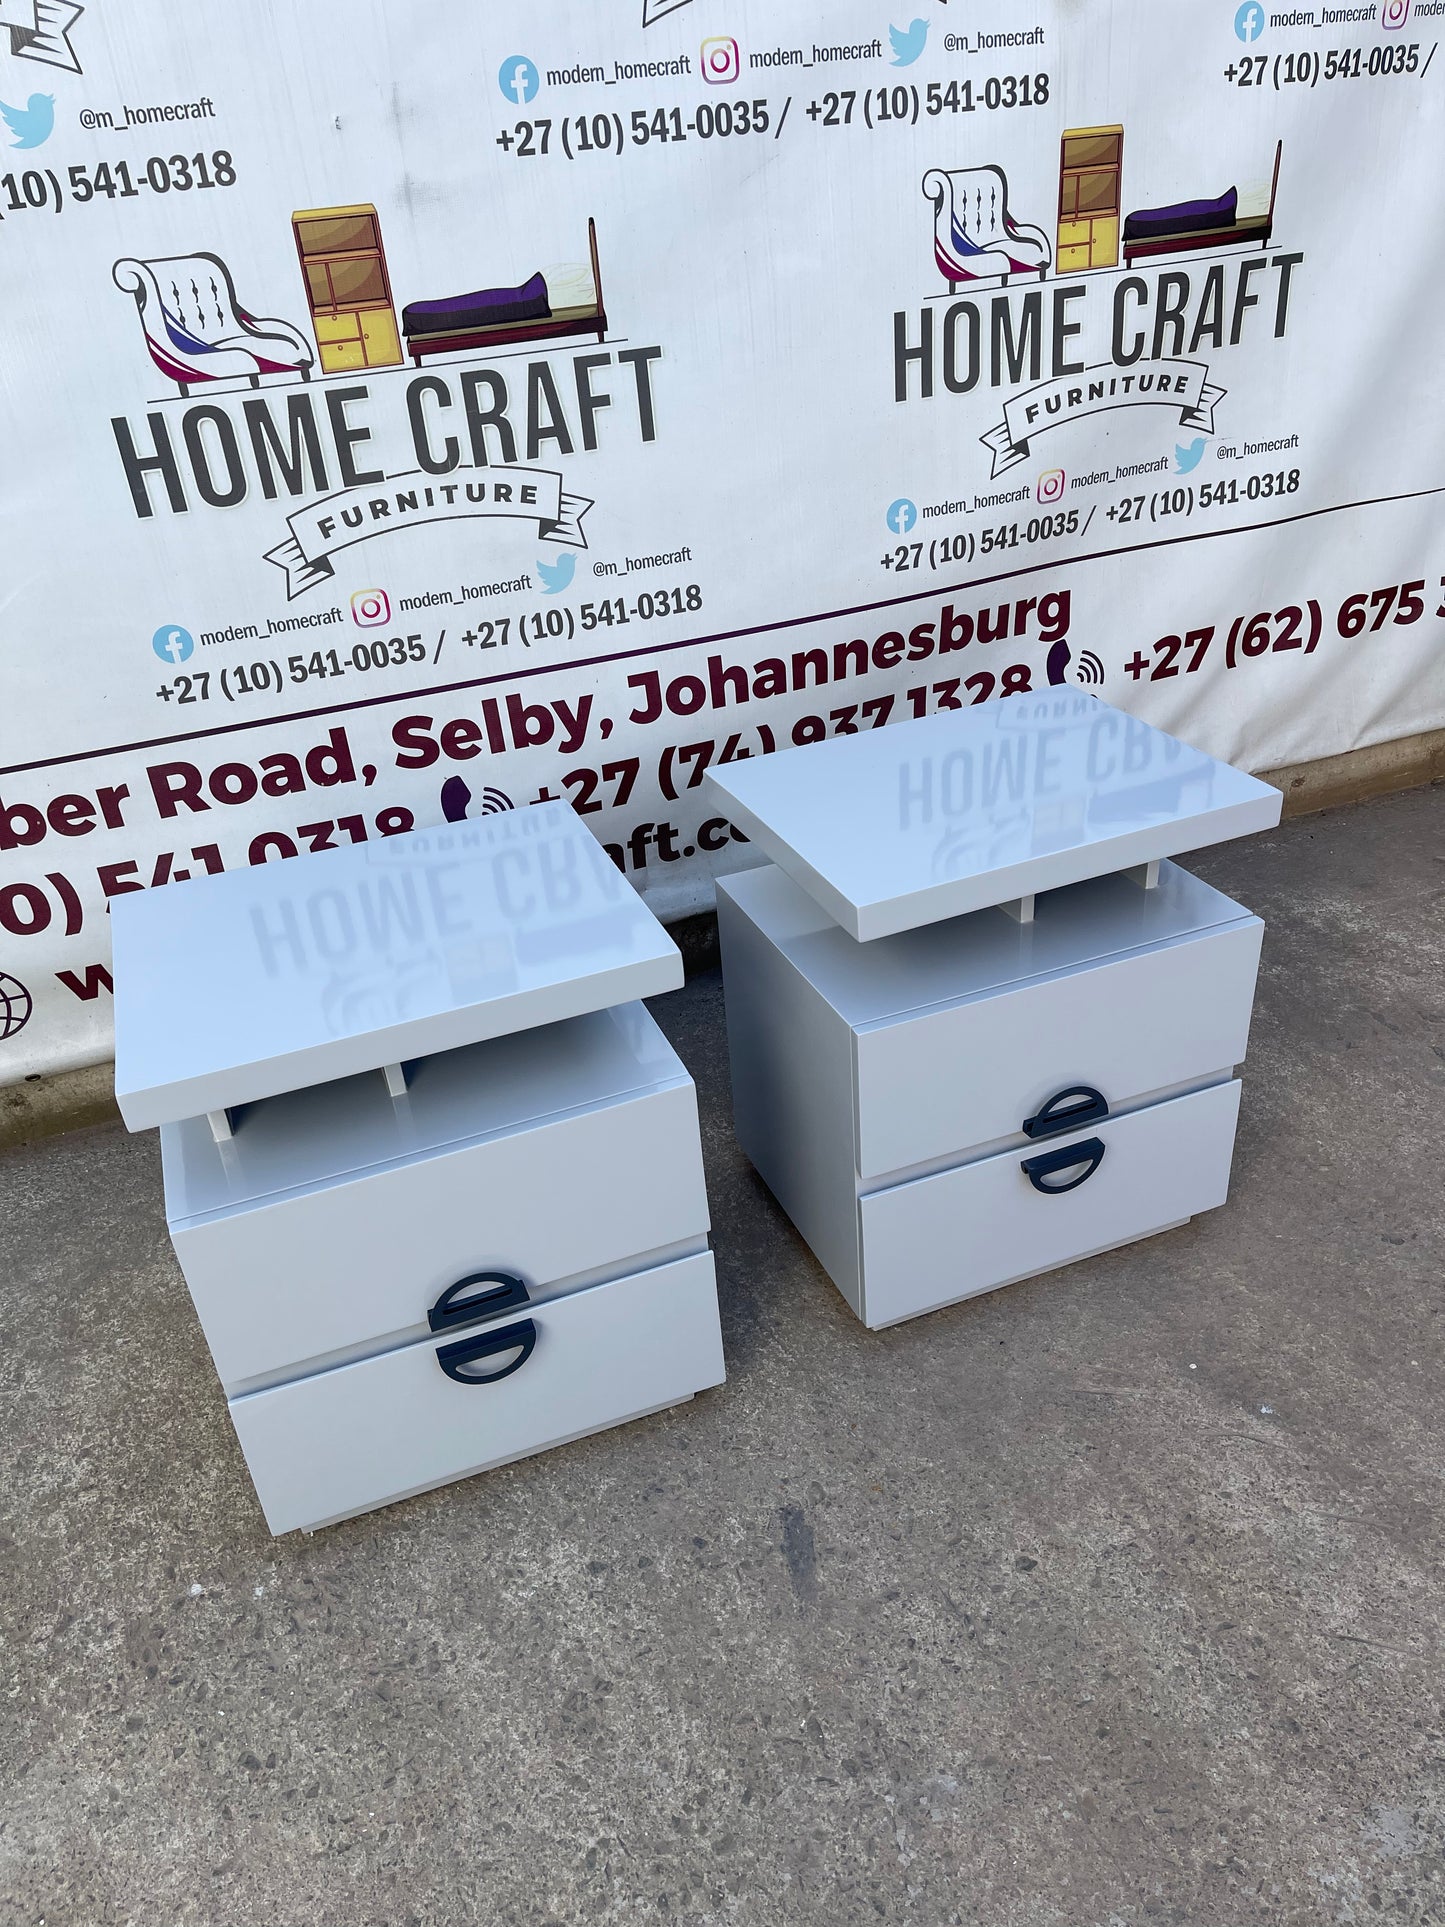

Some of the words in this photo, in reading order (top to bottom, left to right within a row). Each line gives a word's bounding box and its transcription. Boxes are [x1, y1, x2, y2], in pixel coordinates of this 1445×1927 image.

[1271, 4, 1377, 27] modern_homecraft
[750, 39, 882, 67] modern_homecraft
[944, 27, 1044, 53] @m_homecraft
[547, 55, 691, 85] modern_homecraft
[1224, 56, 1268, 86] +27
[1274, 52, 1319, 90] (10)
[1324, 44, 1419, 79] 541-0035
[80, 97, 215, 130] @m_homecraft
[496, 120, 551, 156] +27
[562, 114, 623, 159] (10)
[632, 99, 769, 145] 541-0035
[806, 91, 856, 126] +27
[864, 86, 919, 129] (10)
[927, 73, 1049, 115] 541-0318
[0, 168, 64, 220] 10)
[68, 151, 236, 201] 541-0318
[894, 285, 1086, 407] HOME
[1112, 252, 1304, 366] CRAFT
[1026, 375, 1188, 424] FURNITURE
[111, 386, 386, 518] HOME
[406, 346, 661, 474] CRAFT
[1217, 434, 1298, 459] @m_homecraft
[1071, 457, 1168, 488] modern_homecraft
[317, 484, 537, 539] FURNITURE
[881, 543, 923, 572] +27
[930, 533, 975, 570] (10)
[981, 509, 1079, 553] 541-0035
[1106, 496, 1145, 523] +27
[1151, 487, 1193, 522] (10)
[1199, 469, 1300, 508] 541-0318
[923, 486, 1030, 518] modern_homecraft
[593, 547, 692, 576] @m_homecraft
[400, 575, 532, 611] modern_homecraft
[156, 672, 209, 704] +27
[221, 661, 282, 701] (10)
[288, 634, 425, 683] 541-0035
[462, 618, 510, 649] +27
[520, 608, 574, 647] (10)
[581, 585, 702, 630] 541-0318
[200, 608, 343, 645] modern_homecraft
[1125, 626, 1215, 681] +27
[1226, 600, 1322, 669] (62)
[1337, 580, 1425, 638] 675
[146, 727, 377, 819] Road,
[392, 693, 613, 769] Selby,
[627, 585, 1071, 729] Johannesburg
